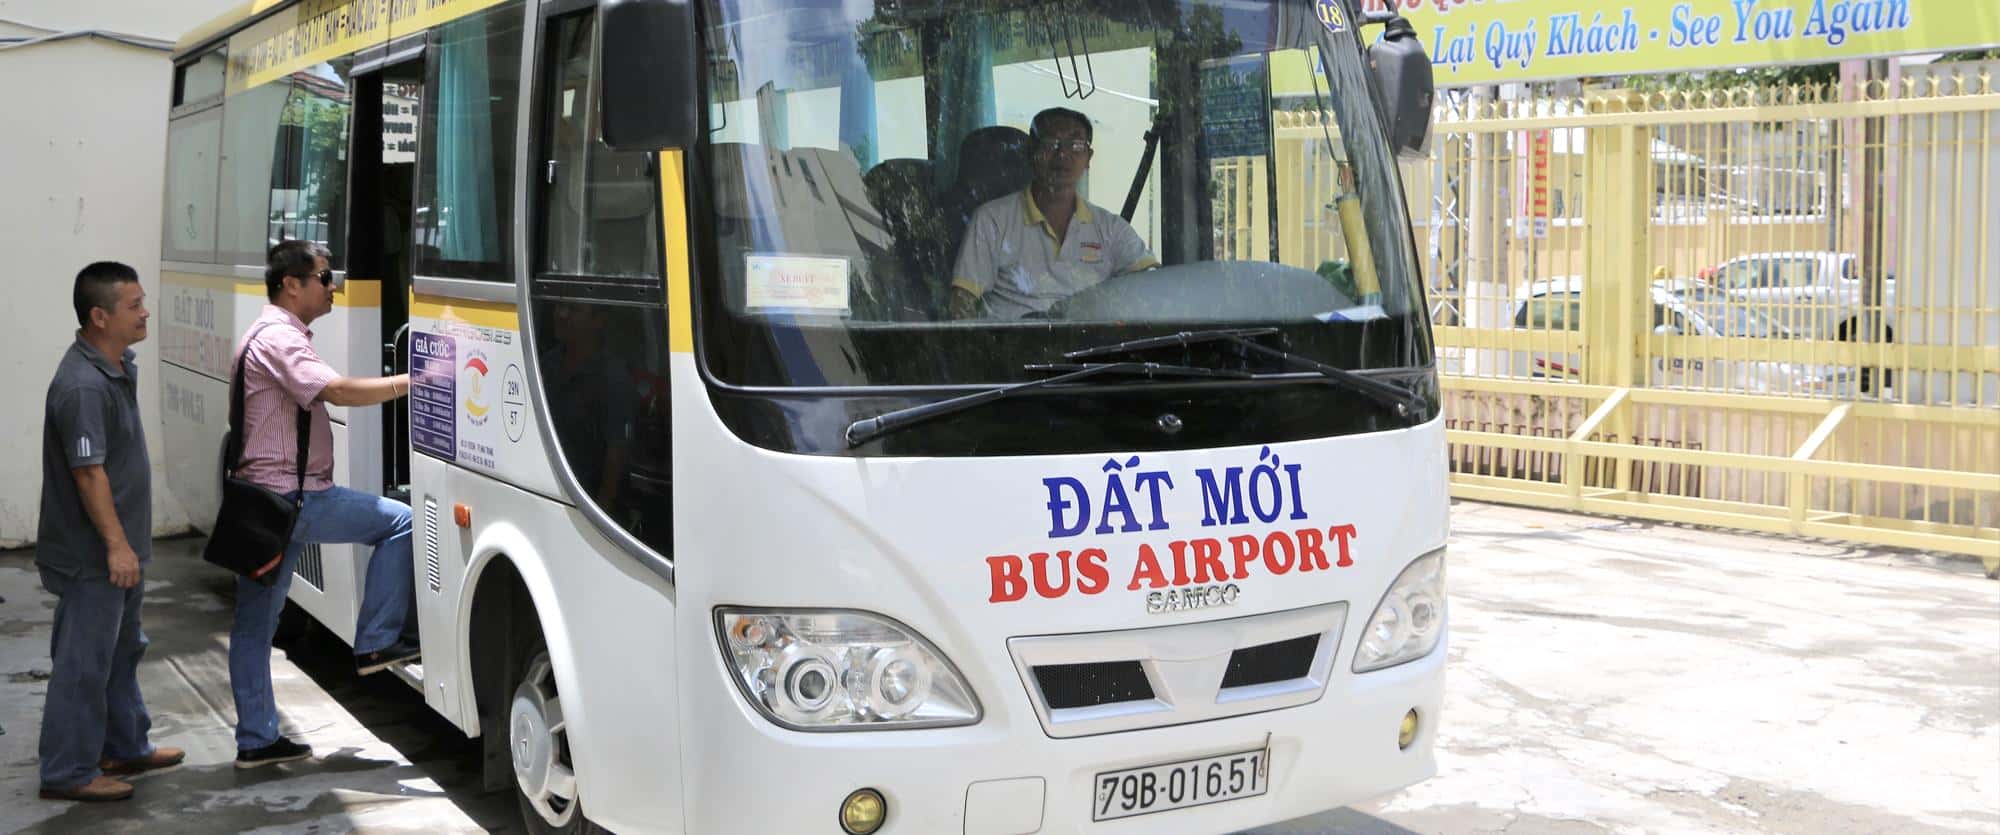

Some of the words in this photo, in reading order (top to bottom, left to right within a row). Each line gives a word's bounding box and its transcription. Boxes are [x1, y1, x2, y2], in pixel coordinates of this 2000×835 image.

[1319, 3, 1343, 26] 18
[1431, 23, 1475, 72] Lại
[1485, 20, 1537, 68] Quý
[1546, 9, 1639, 56] Khách
[1668, 4, 1721, 47] See
[1733, 0, 1793, 42] You
[1803, 0, 1910, 45] Again
[1042, 455, 1174, 538] ĐẤT
[1195, 445, 1308, 527] MỚI
[985, 548, 1110, 604] BUS
[1127, 523, 1358, 591] AIRPORT
[1147, 582, 1241, 614] SAMCO
[1101, 754, 1259, 816] 79B-016.51
